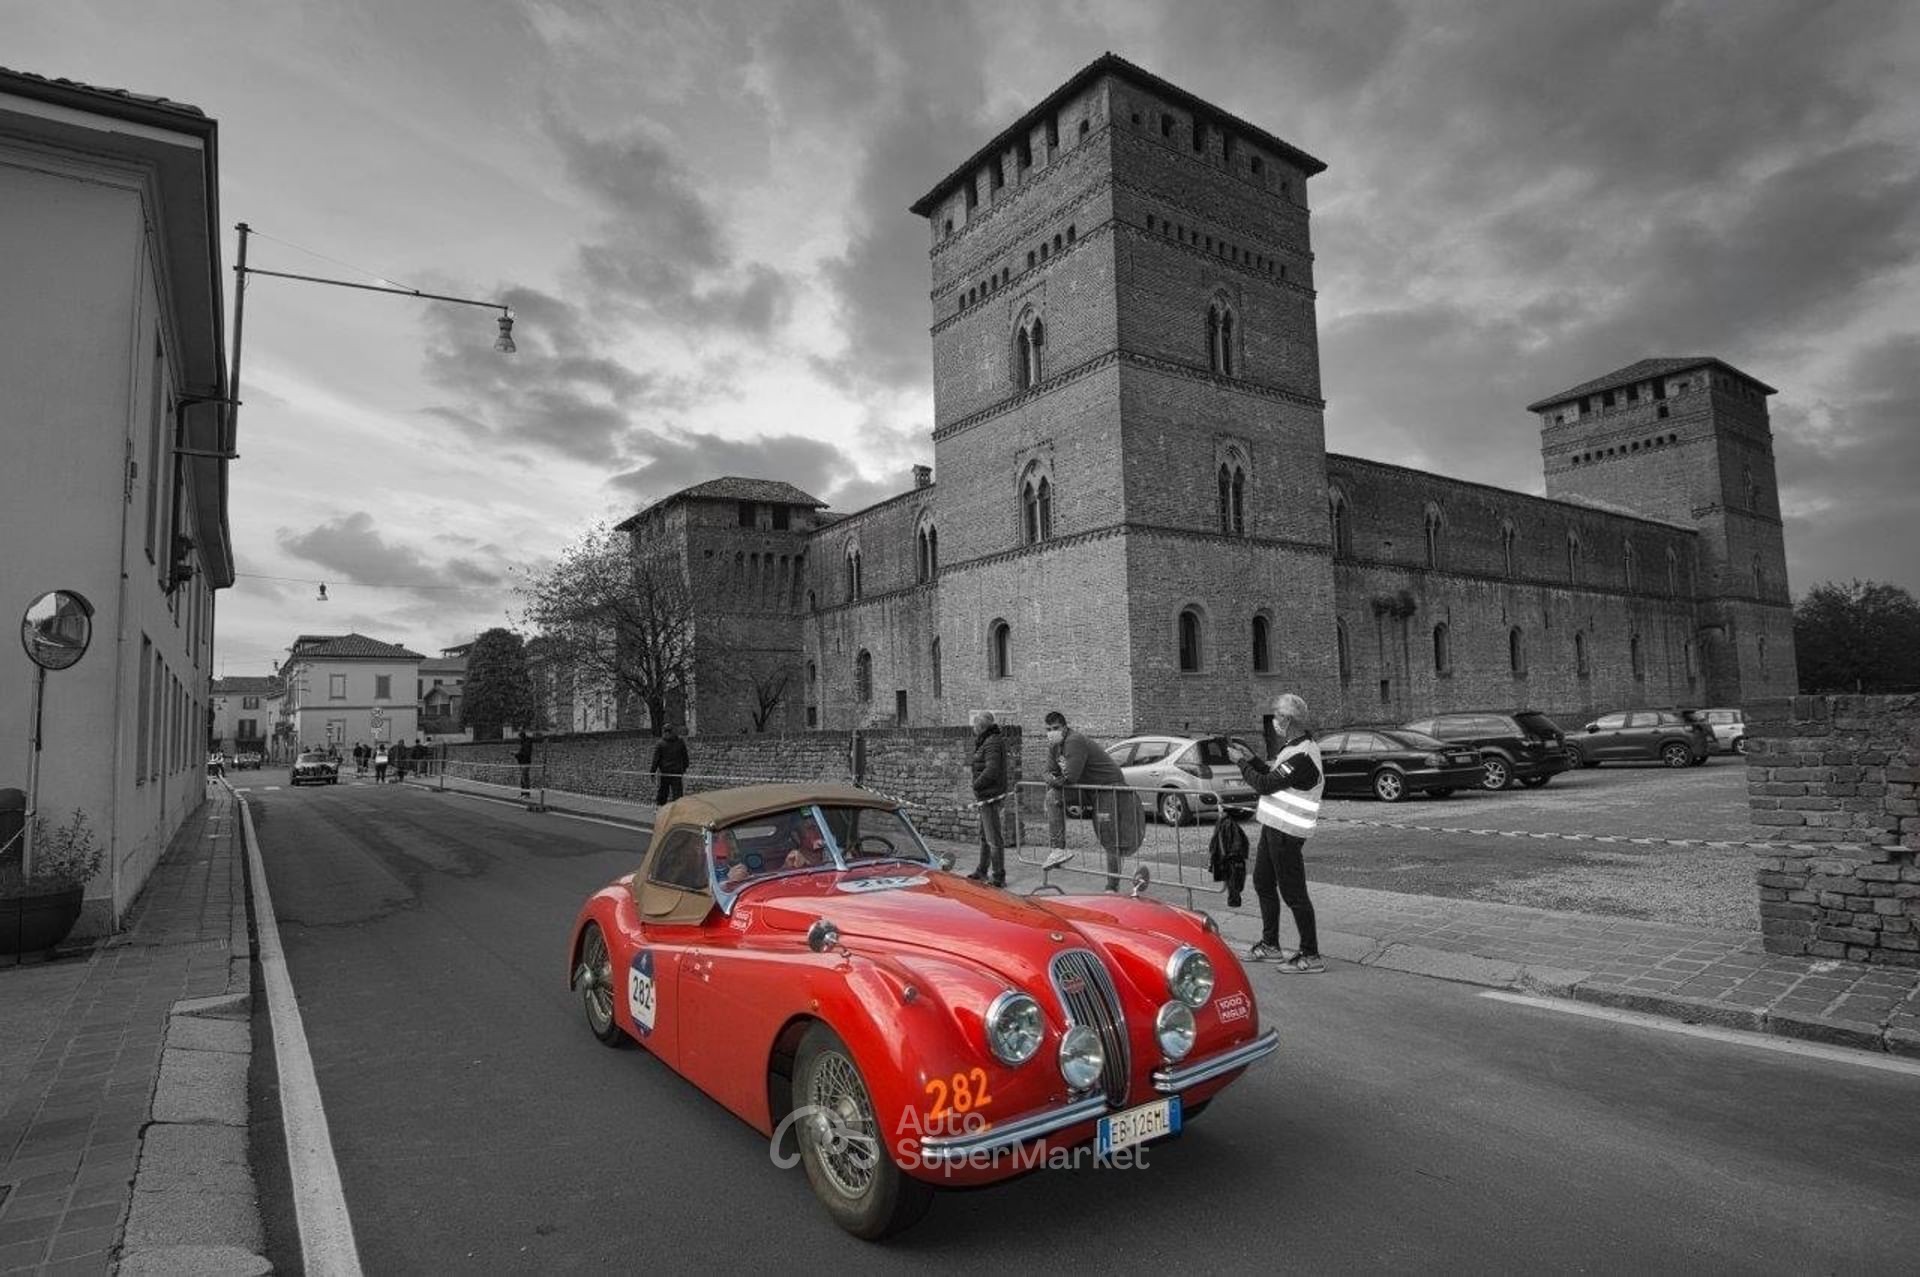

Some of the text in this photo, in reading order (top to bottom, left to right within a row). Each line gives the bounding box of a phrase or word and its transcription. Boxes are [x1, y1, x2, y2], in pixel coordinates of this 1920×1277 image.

[633, 976, 651, 1010] 282
[1220, 997, 1242, 1009] 1000
[925, 1067, 992, 1120] 282
